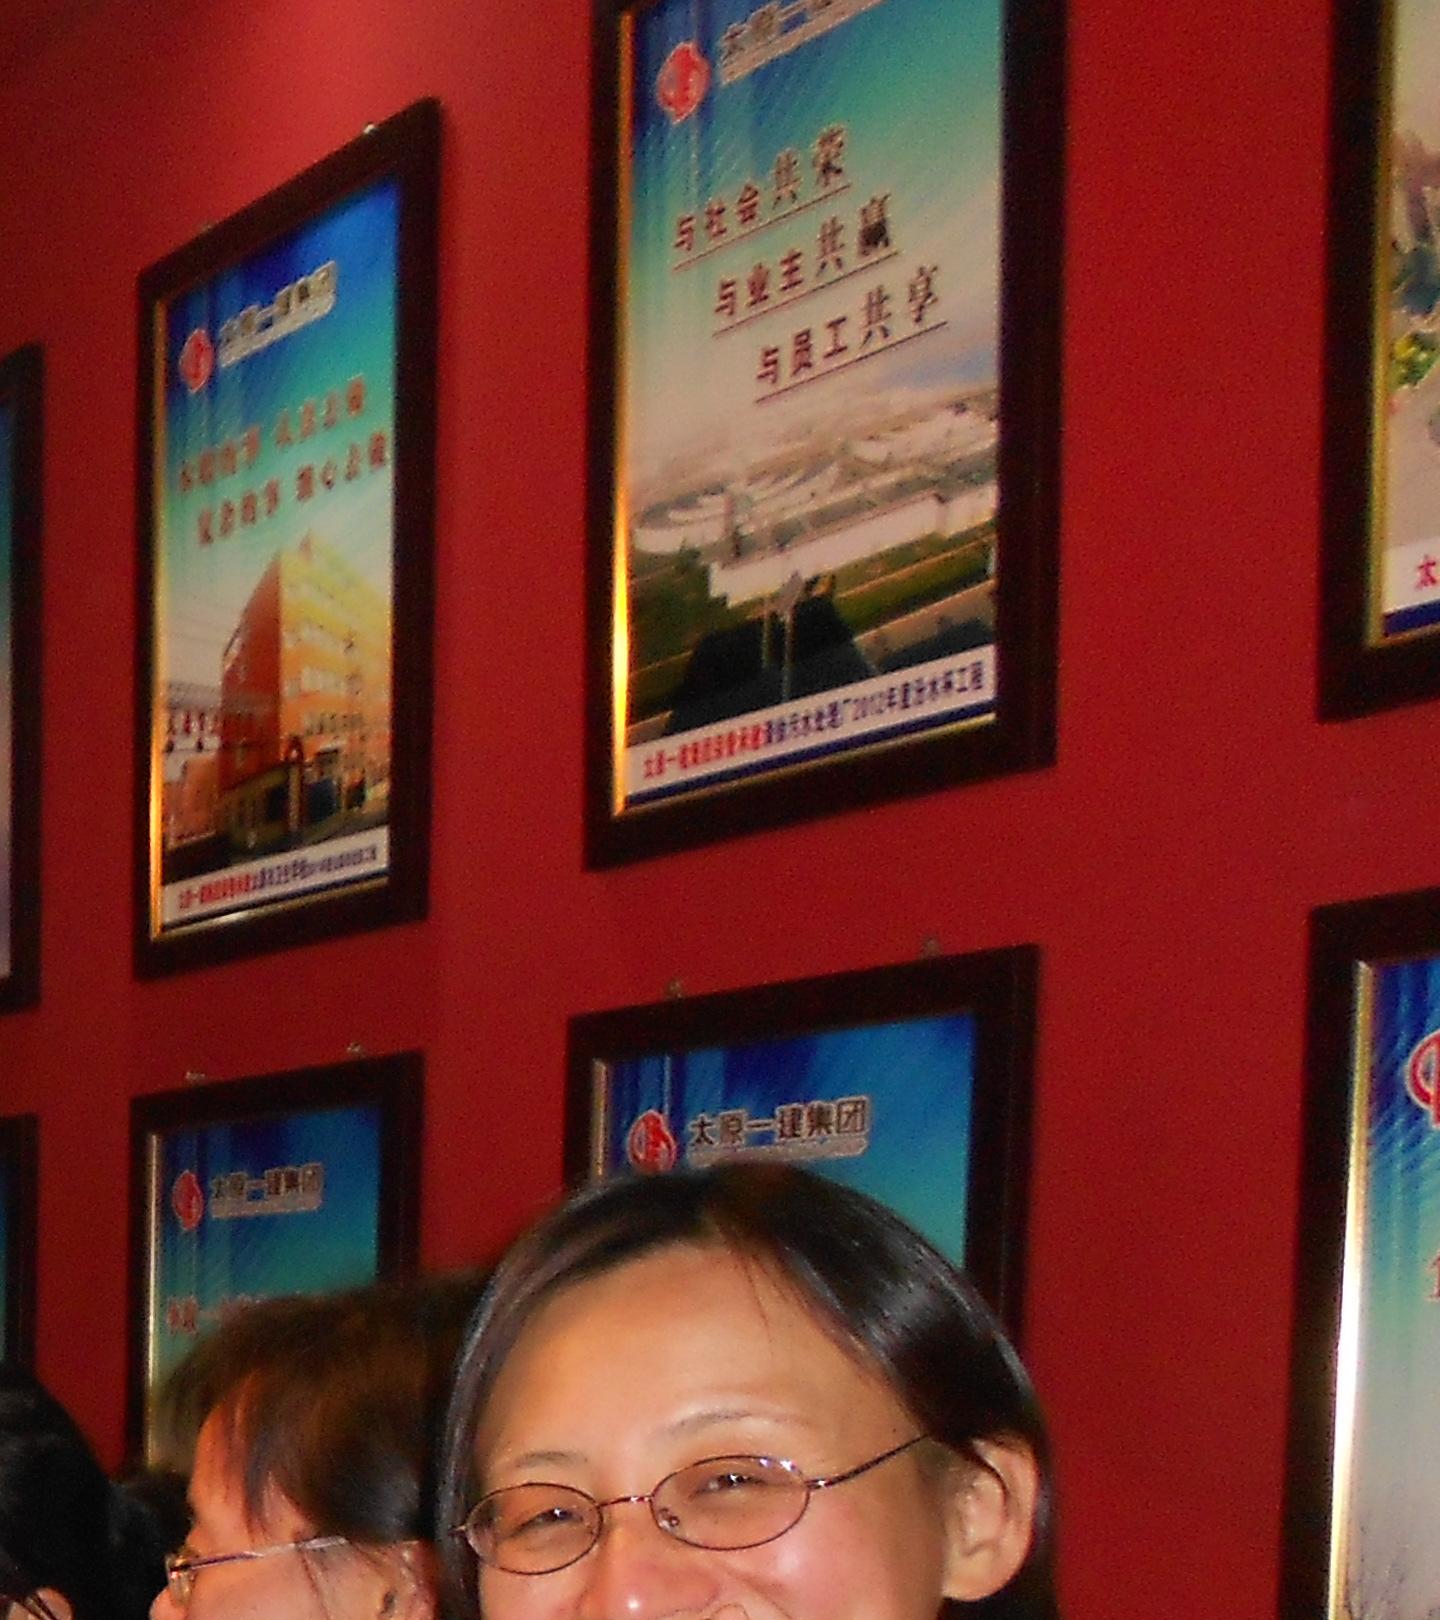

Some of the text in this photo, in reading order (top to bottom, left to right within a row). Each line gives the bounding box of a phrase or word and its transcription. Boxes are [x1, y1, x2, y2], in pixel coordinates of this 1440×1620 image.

[714, 192, 892, 317] 与业主共赢
[756, 264, 939, 385] 与员工共享
[688, 1097, 868, 1148] 太原一建集团
